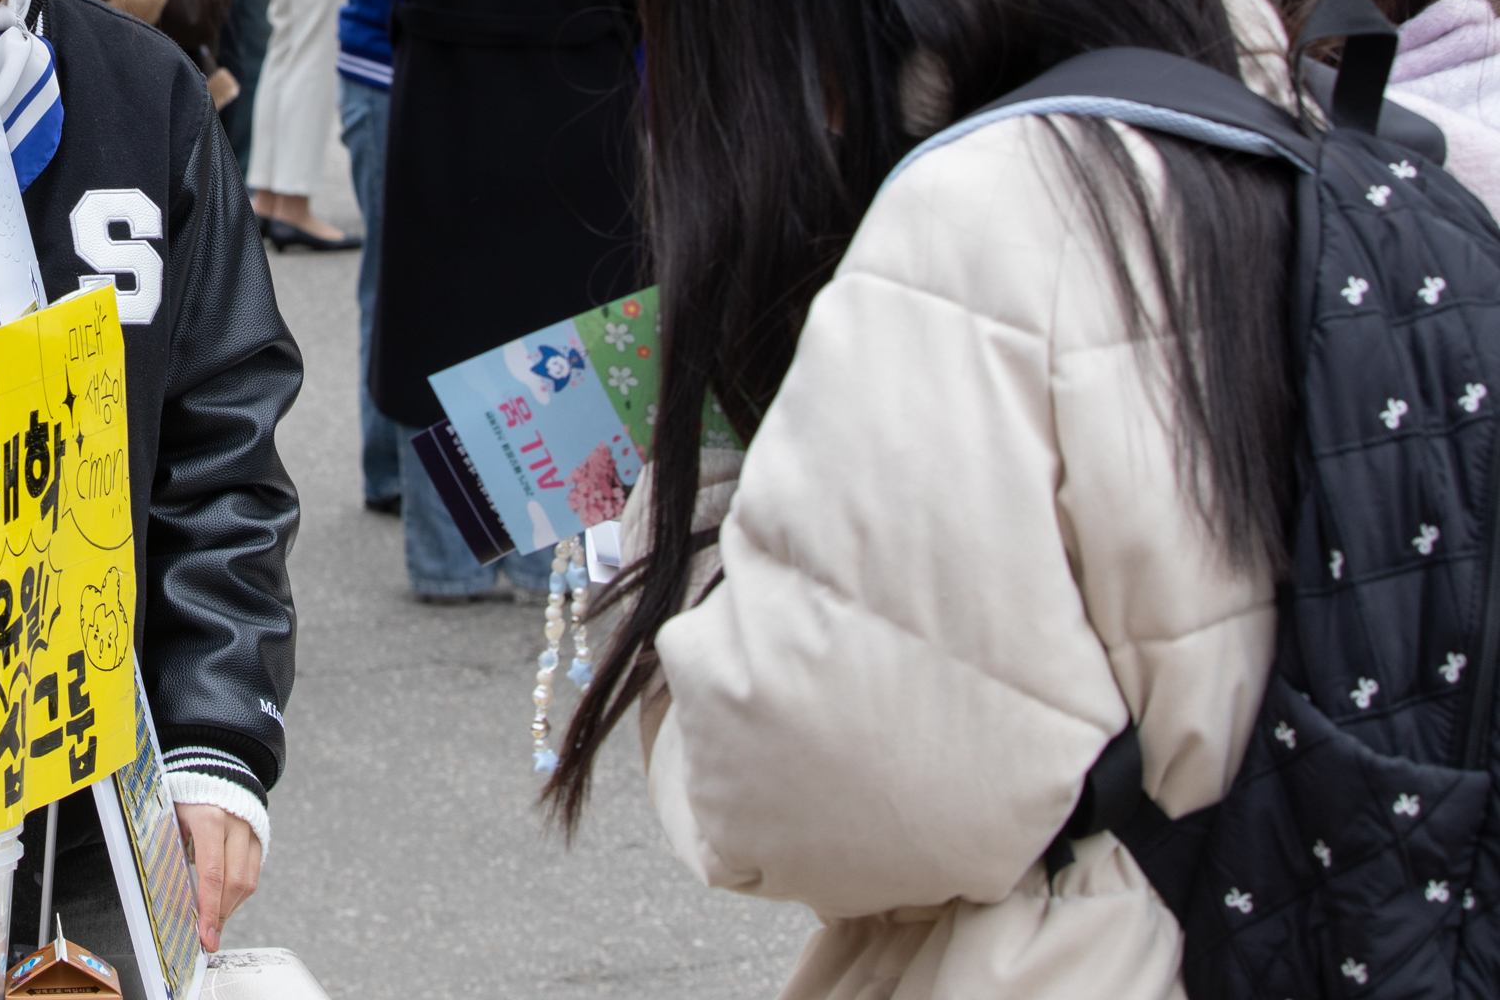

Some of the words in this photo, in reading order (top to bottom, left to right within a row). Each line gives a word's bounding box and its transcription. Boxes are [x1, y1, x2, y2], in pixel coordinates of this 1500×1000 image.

[69, 188, 163, 325] S
[68, 313, 105, 362] 미대
[498, 395, 533, 429] 봄
[520, 430, 565, 490] ALL
